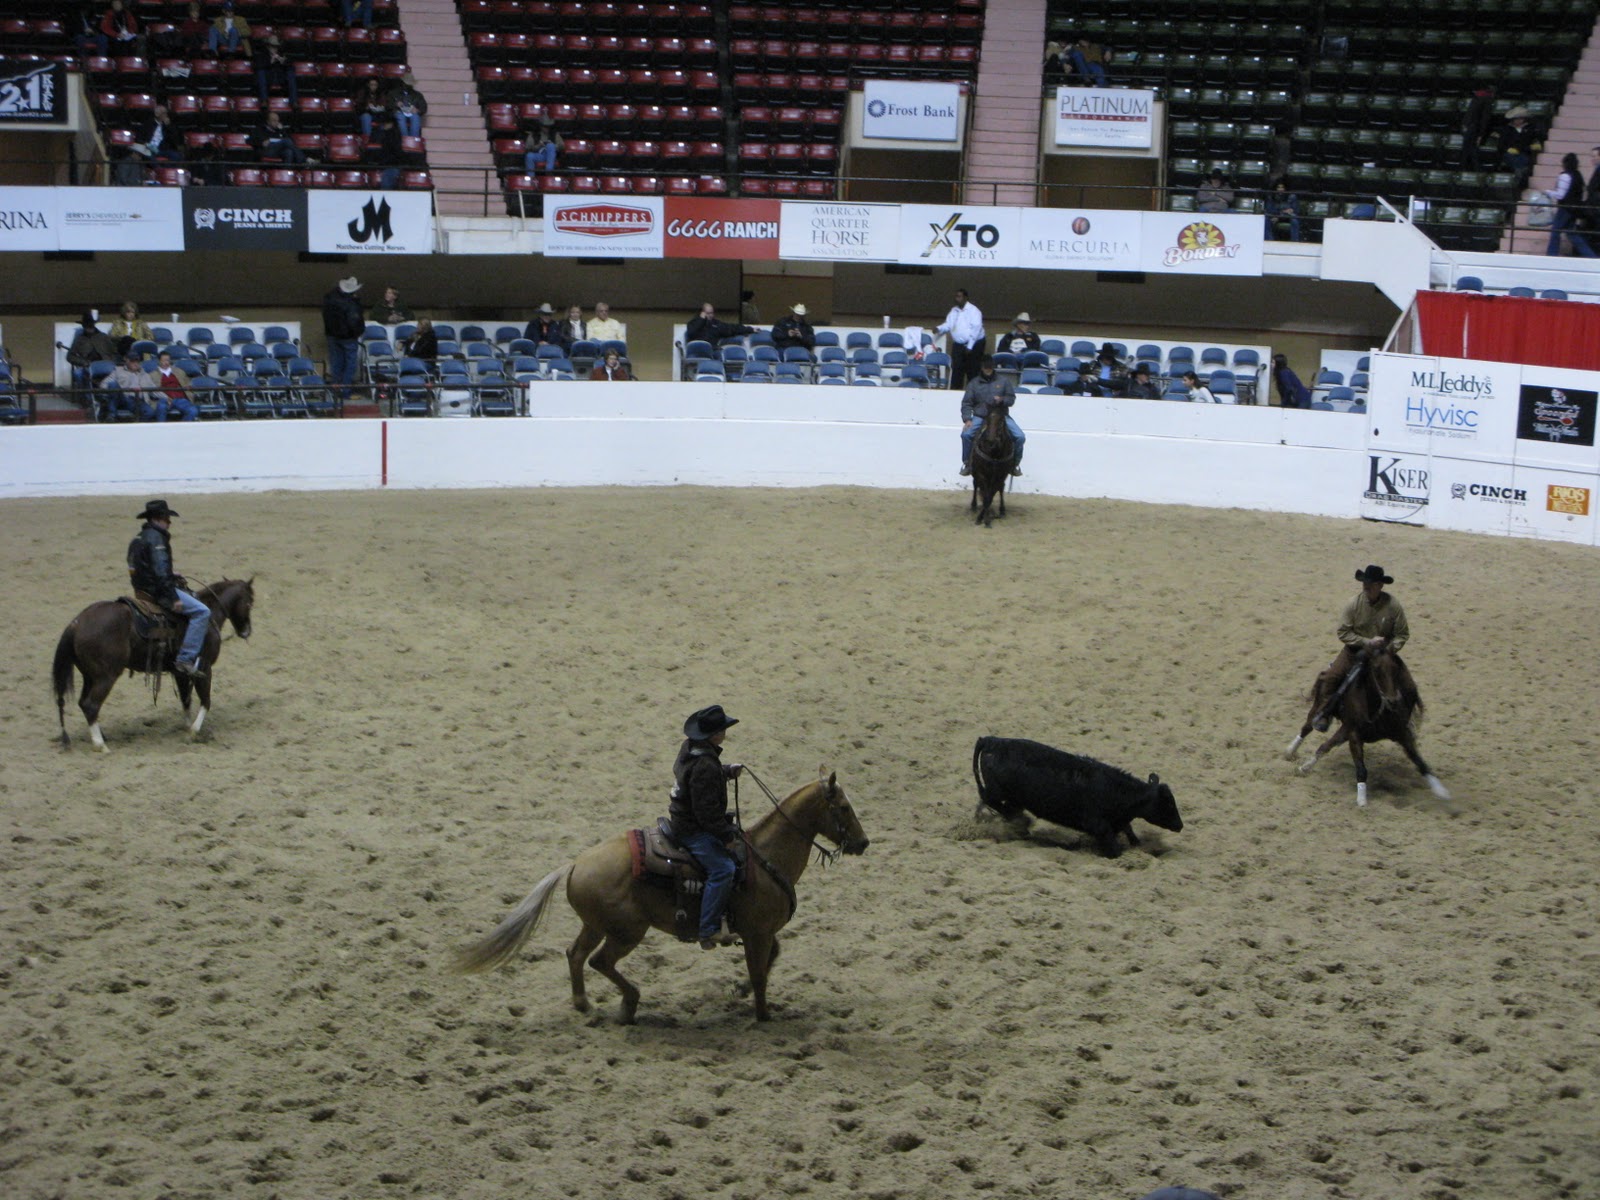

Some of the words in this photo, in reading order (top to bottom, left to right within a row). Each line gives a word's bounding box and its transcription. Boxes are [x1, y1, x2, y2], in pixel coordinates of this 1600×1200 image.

[888, 103, 919, 117] Frost
[923, 104, 955, 118] Bank
[1060, 95, 1149, 115] PLATINUM
[217, 208, 293, 223] CINCH
[561, 211, 647, 223] SCHNIPPERS
[812, 206, 870, 217] AMERICAN
[723, 221, 779, 239] RANCH
[811, 218, 870, 229] QUARTER
[920, 212, 1000, 258] XTO
[1029, 239, 1131, 254] MERCURIA
[1163, 244, 1240, 267] BORDEN
[1406, 396, 1478, 428] Hyvisc
[1469, 483, 1528, 501] CINCH
